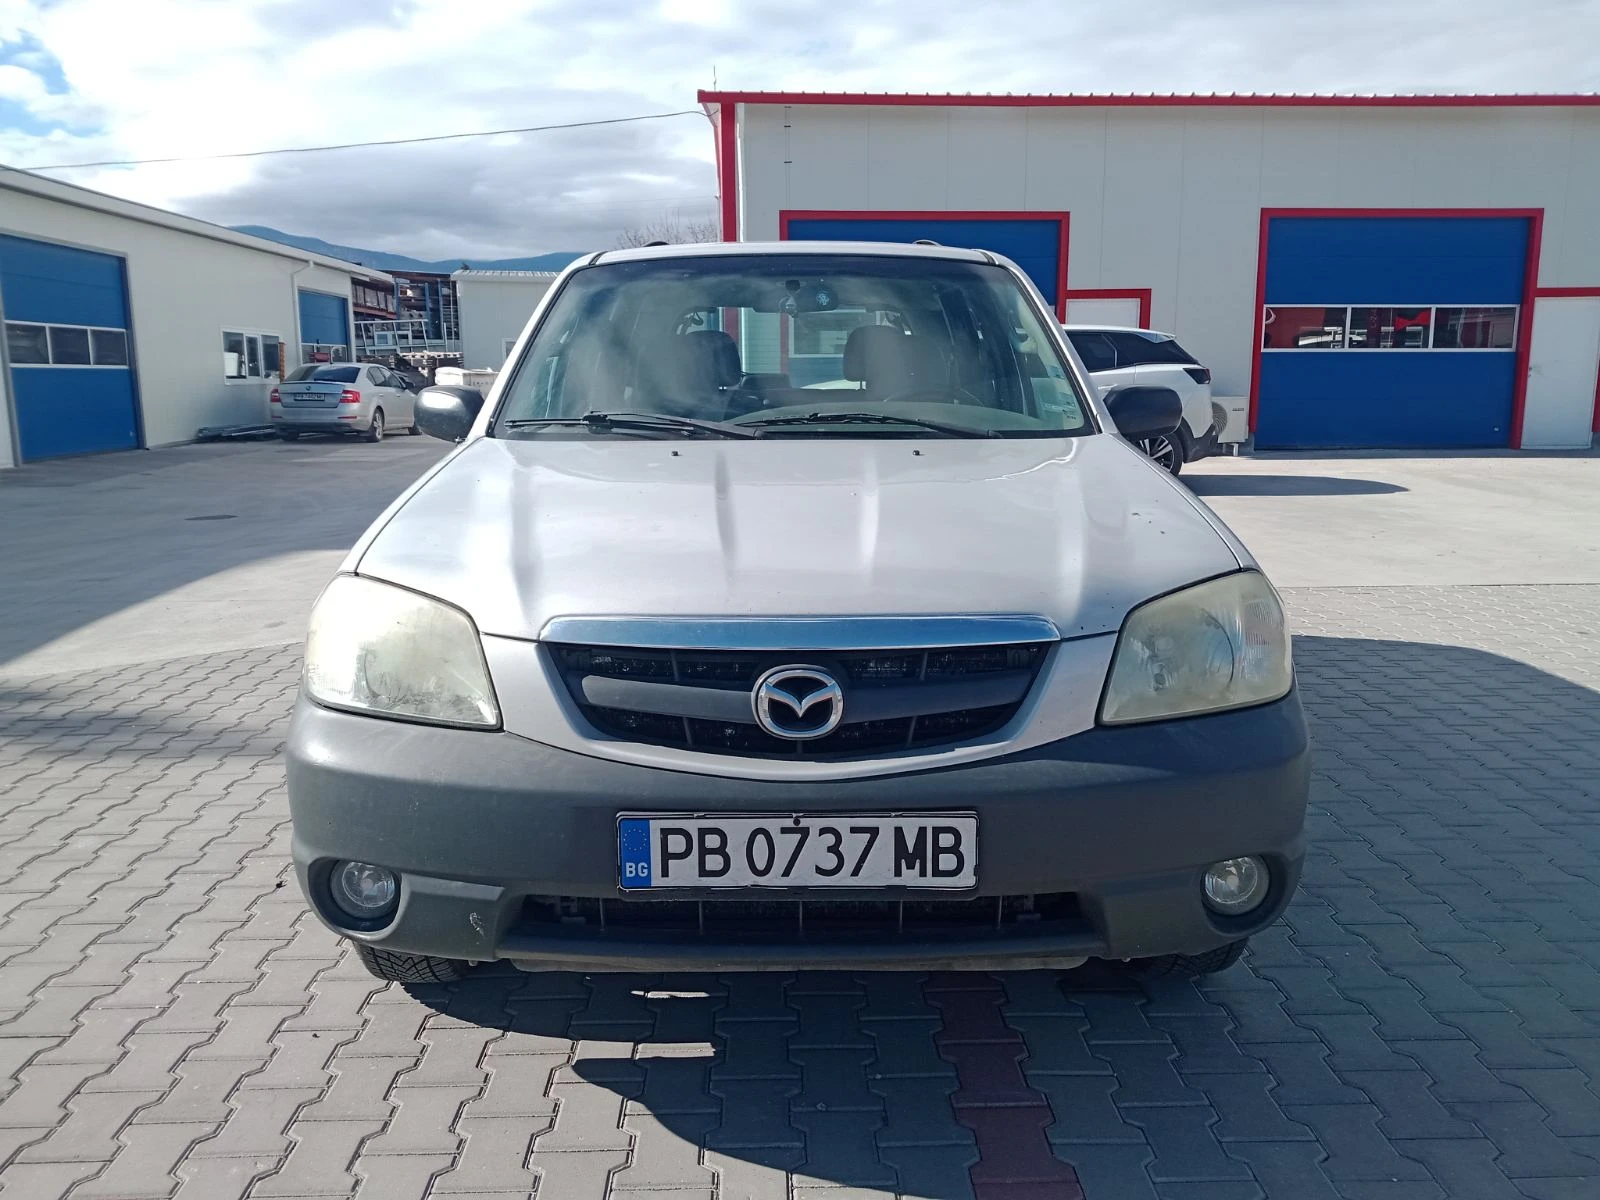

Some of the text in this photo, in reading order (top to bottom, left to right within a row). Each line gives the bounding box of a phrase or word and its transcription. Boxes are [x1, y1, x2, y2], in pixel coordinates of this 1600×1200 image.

[660, 826, 965, 878] PB 0737 MB
[625, 862, 648, 878] BG
